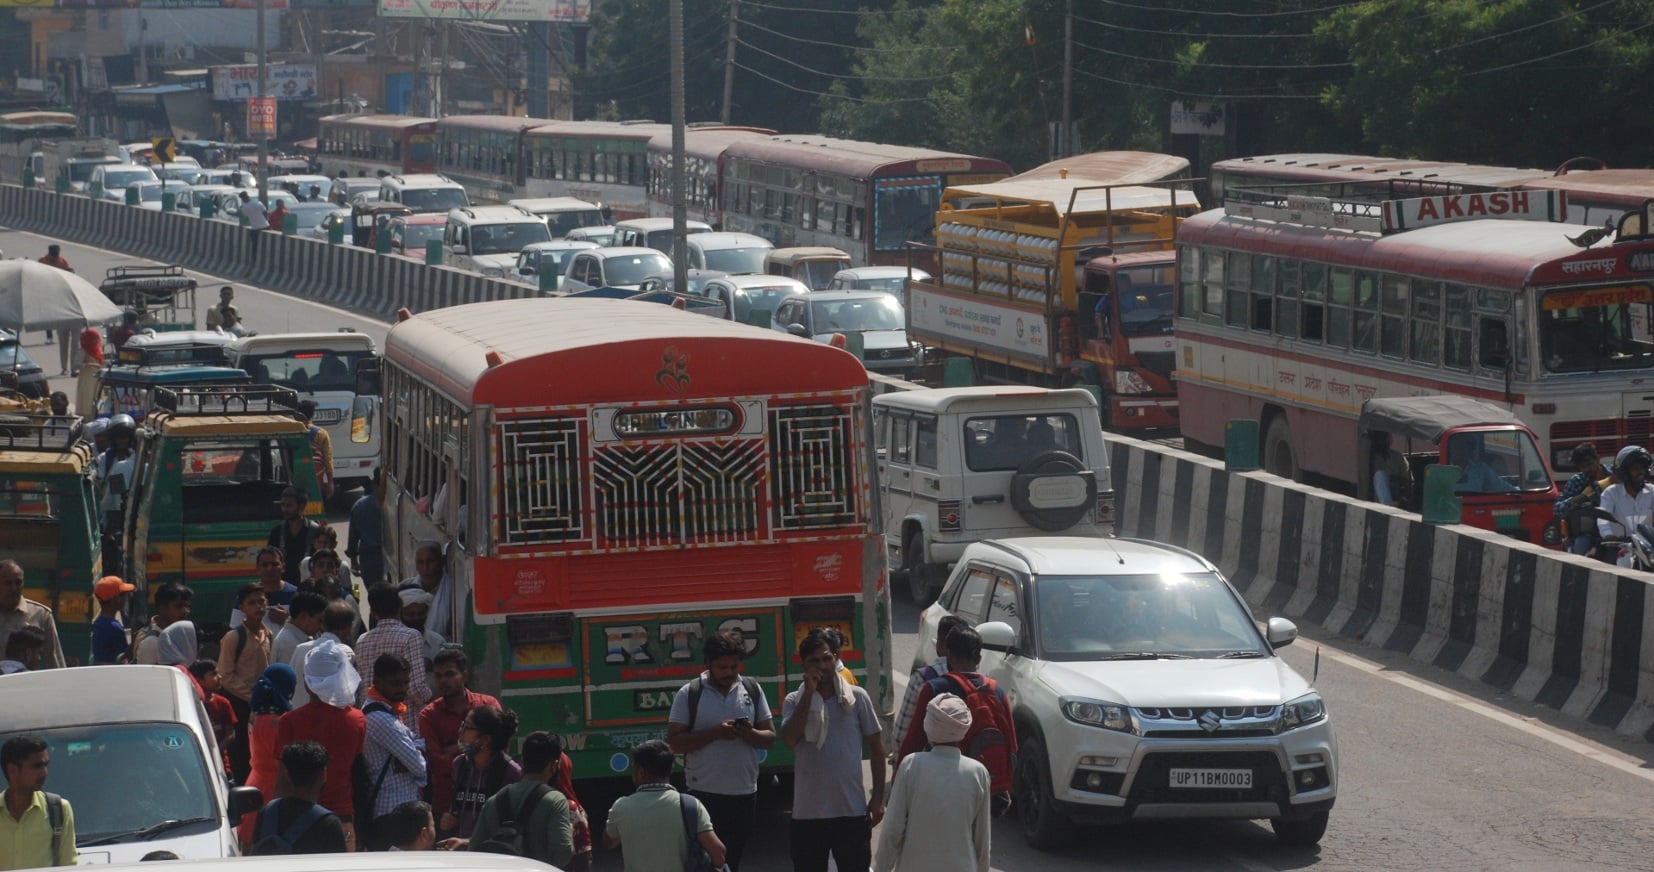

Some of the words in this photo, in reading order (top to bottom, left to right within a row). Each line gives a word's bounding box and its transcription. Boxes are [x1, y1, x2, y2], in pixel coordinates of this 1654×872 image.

[251, 105, 273, 114] OYO
[1417, 191, 1530, 221] AKASH
[1562, 257, 1617, 274] सहारनपुर
[1177, 772, 1251, 785] UP11BM0003
